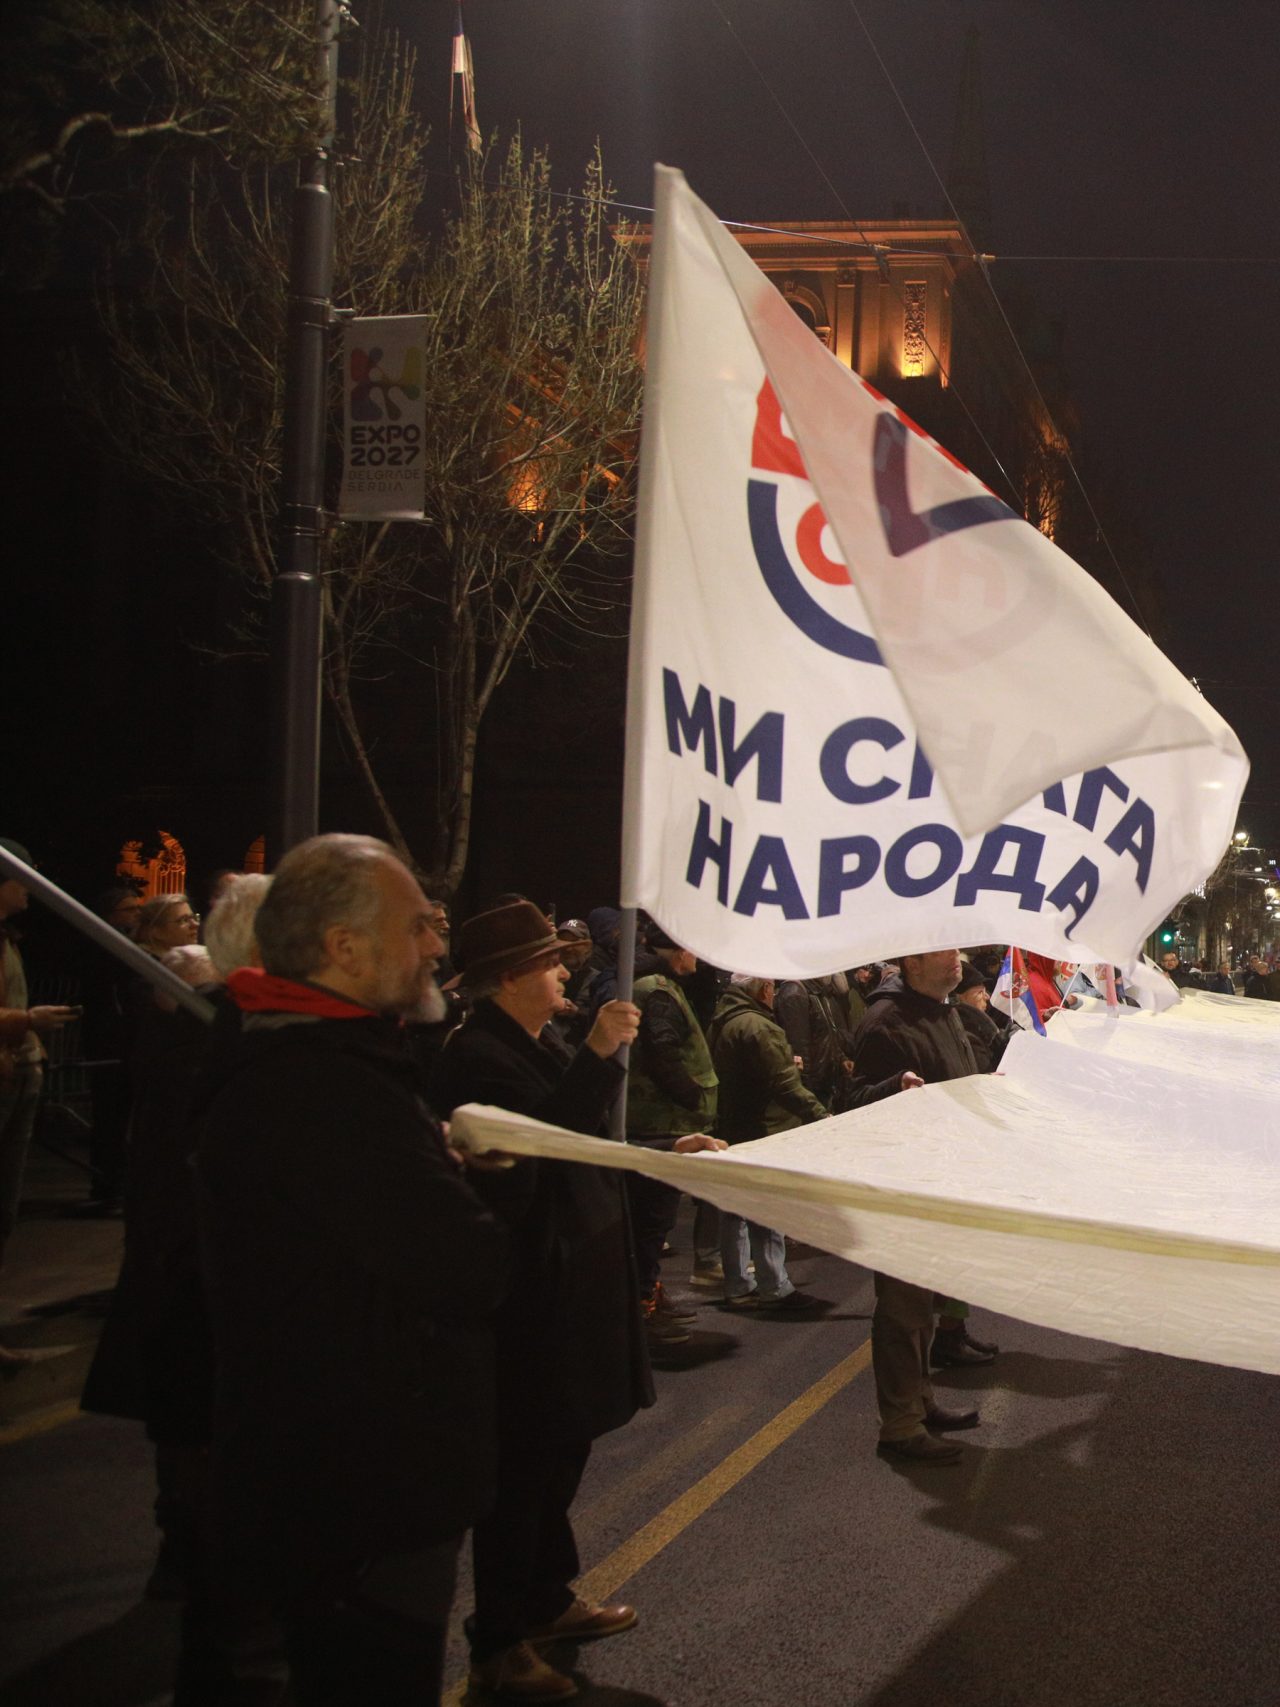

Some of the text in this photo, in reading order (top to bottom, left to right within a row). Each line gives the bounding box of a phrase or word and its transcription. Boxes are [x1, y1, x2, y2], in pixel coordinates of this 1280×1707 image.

[351, 424, 420, 445] EXPO
[351, 446, 420, 466] 2027
[662, 667, 1156, 895] МИ СГА
[685, 800, 1100, 941] НАРОДА
